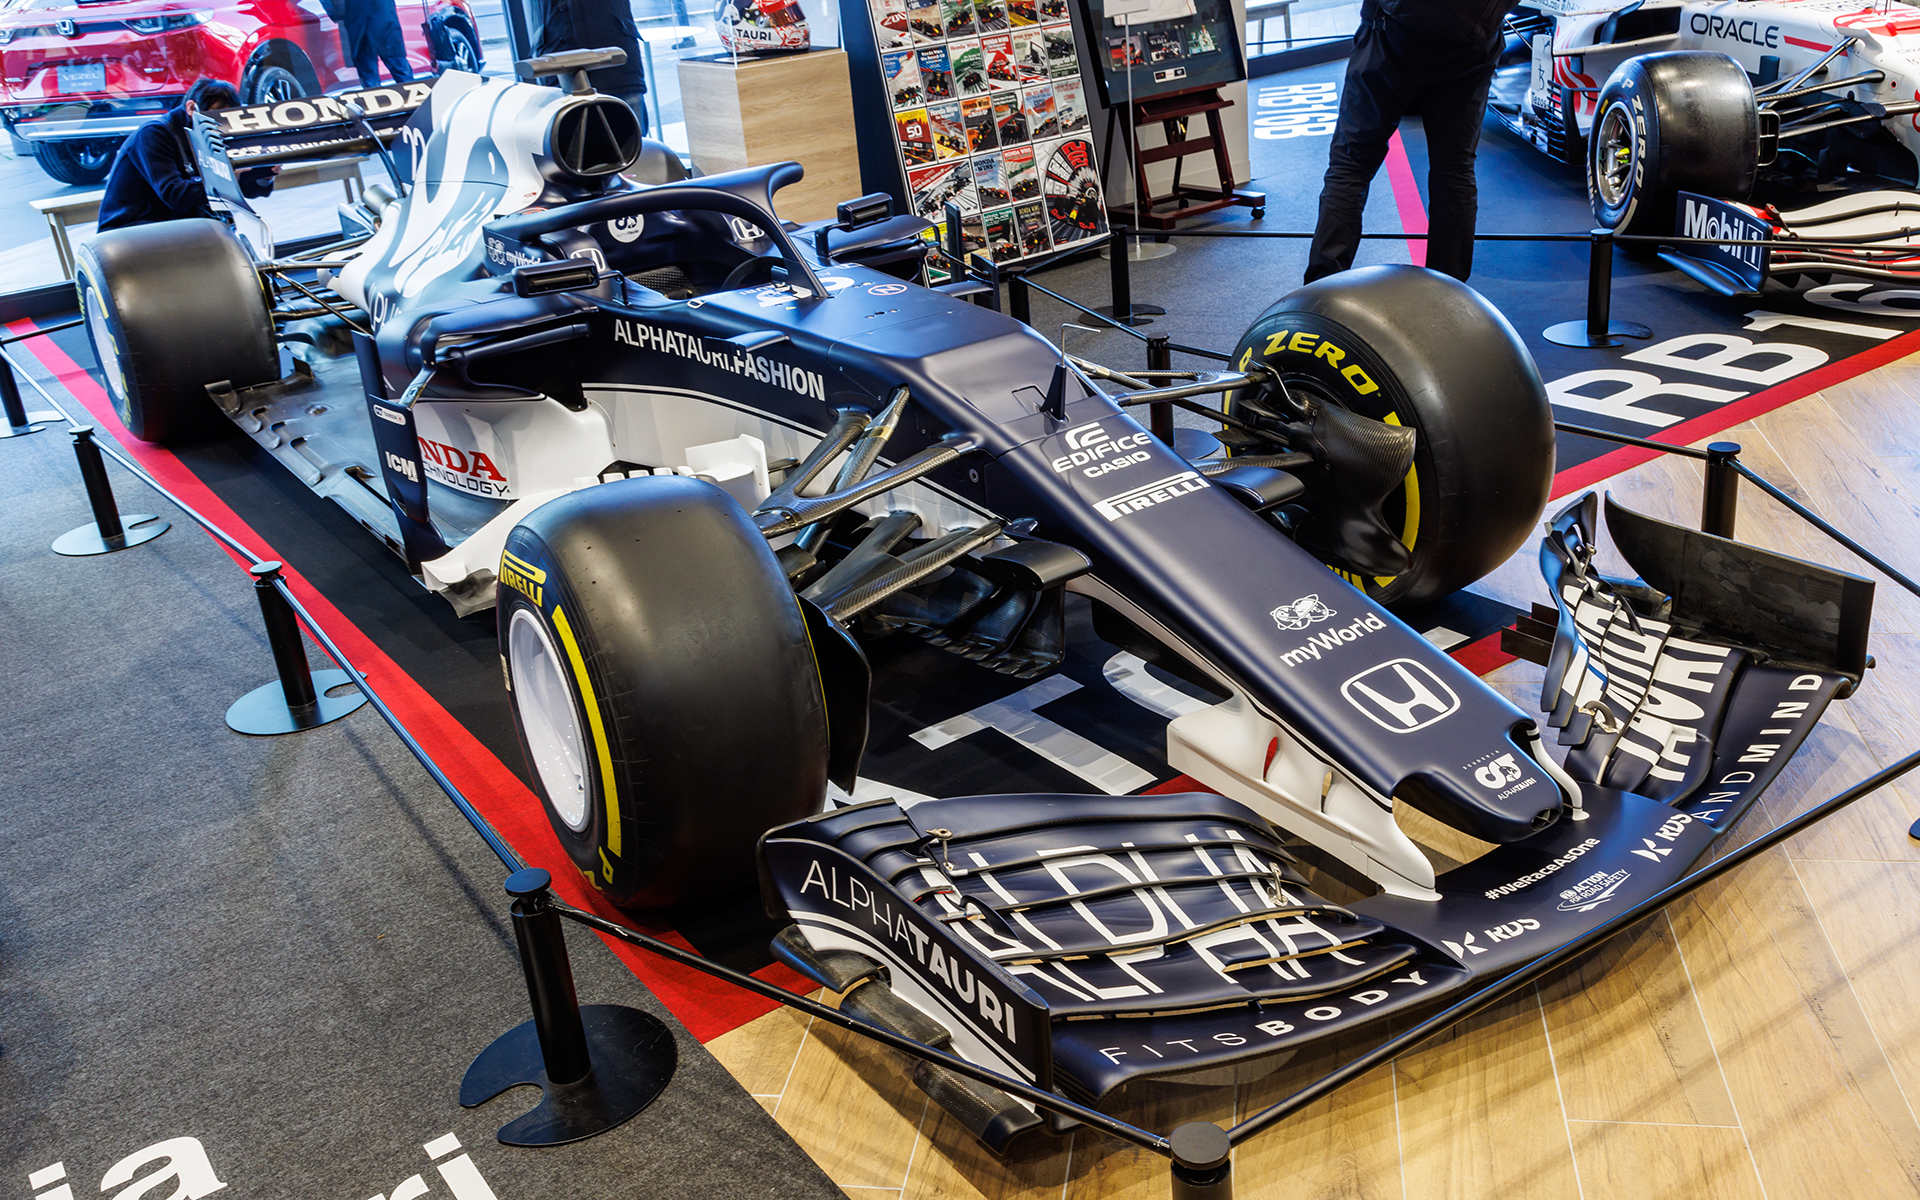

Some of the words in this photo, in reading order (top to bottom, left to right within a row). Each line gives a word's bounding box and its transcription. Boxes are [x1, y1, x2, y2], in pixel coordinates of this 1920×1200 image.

[1690, 13, 1780, 49] ORACLE
[61, 73, 100, 81] VEZEL
[220, 83, 433, 133] HONDA
[906, 125, 923, 138] 50
[1631, 94, 1647, 189] ZERO
[1683, 199, 1745, 259] Mobil
[1264, 329, 1379, 395] ZERO
[385, 451, 417, 479] ICM
[418, 436, 507, 482] NDA
[1051, 432, 1153, 475] EDIFICE
[1083, 450, 1152, 479] CASIO
[423, 461, 508, 497] CHNOLOGY
[1092, 471, 1212, 522] PIRELLI
[500, 549, 547, 607] PIRELLI
[1279, 612, 1388, 668] myWorld
[1497, 777, 1538, 801] ALPHATAURI
[1484, 836, 1601, 900] #WeRaceAsOne
[1569, 893, 1583, 904] FOR
[1580, 884, 1604, 898] ROAD
[1602, 868, 1629, 887] SAFETY
[1572, 870, 1609, 893] ACTION
[800, 860, 1017, 1044] ALPHATAURI
